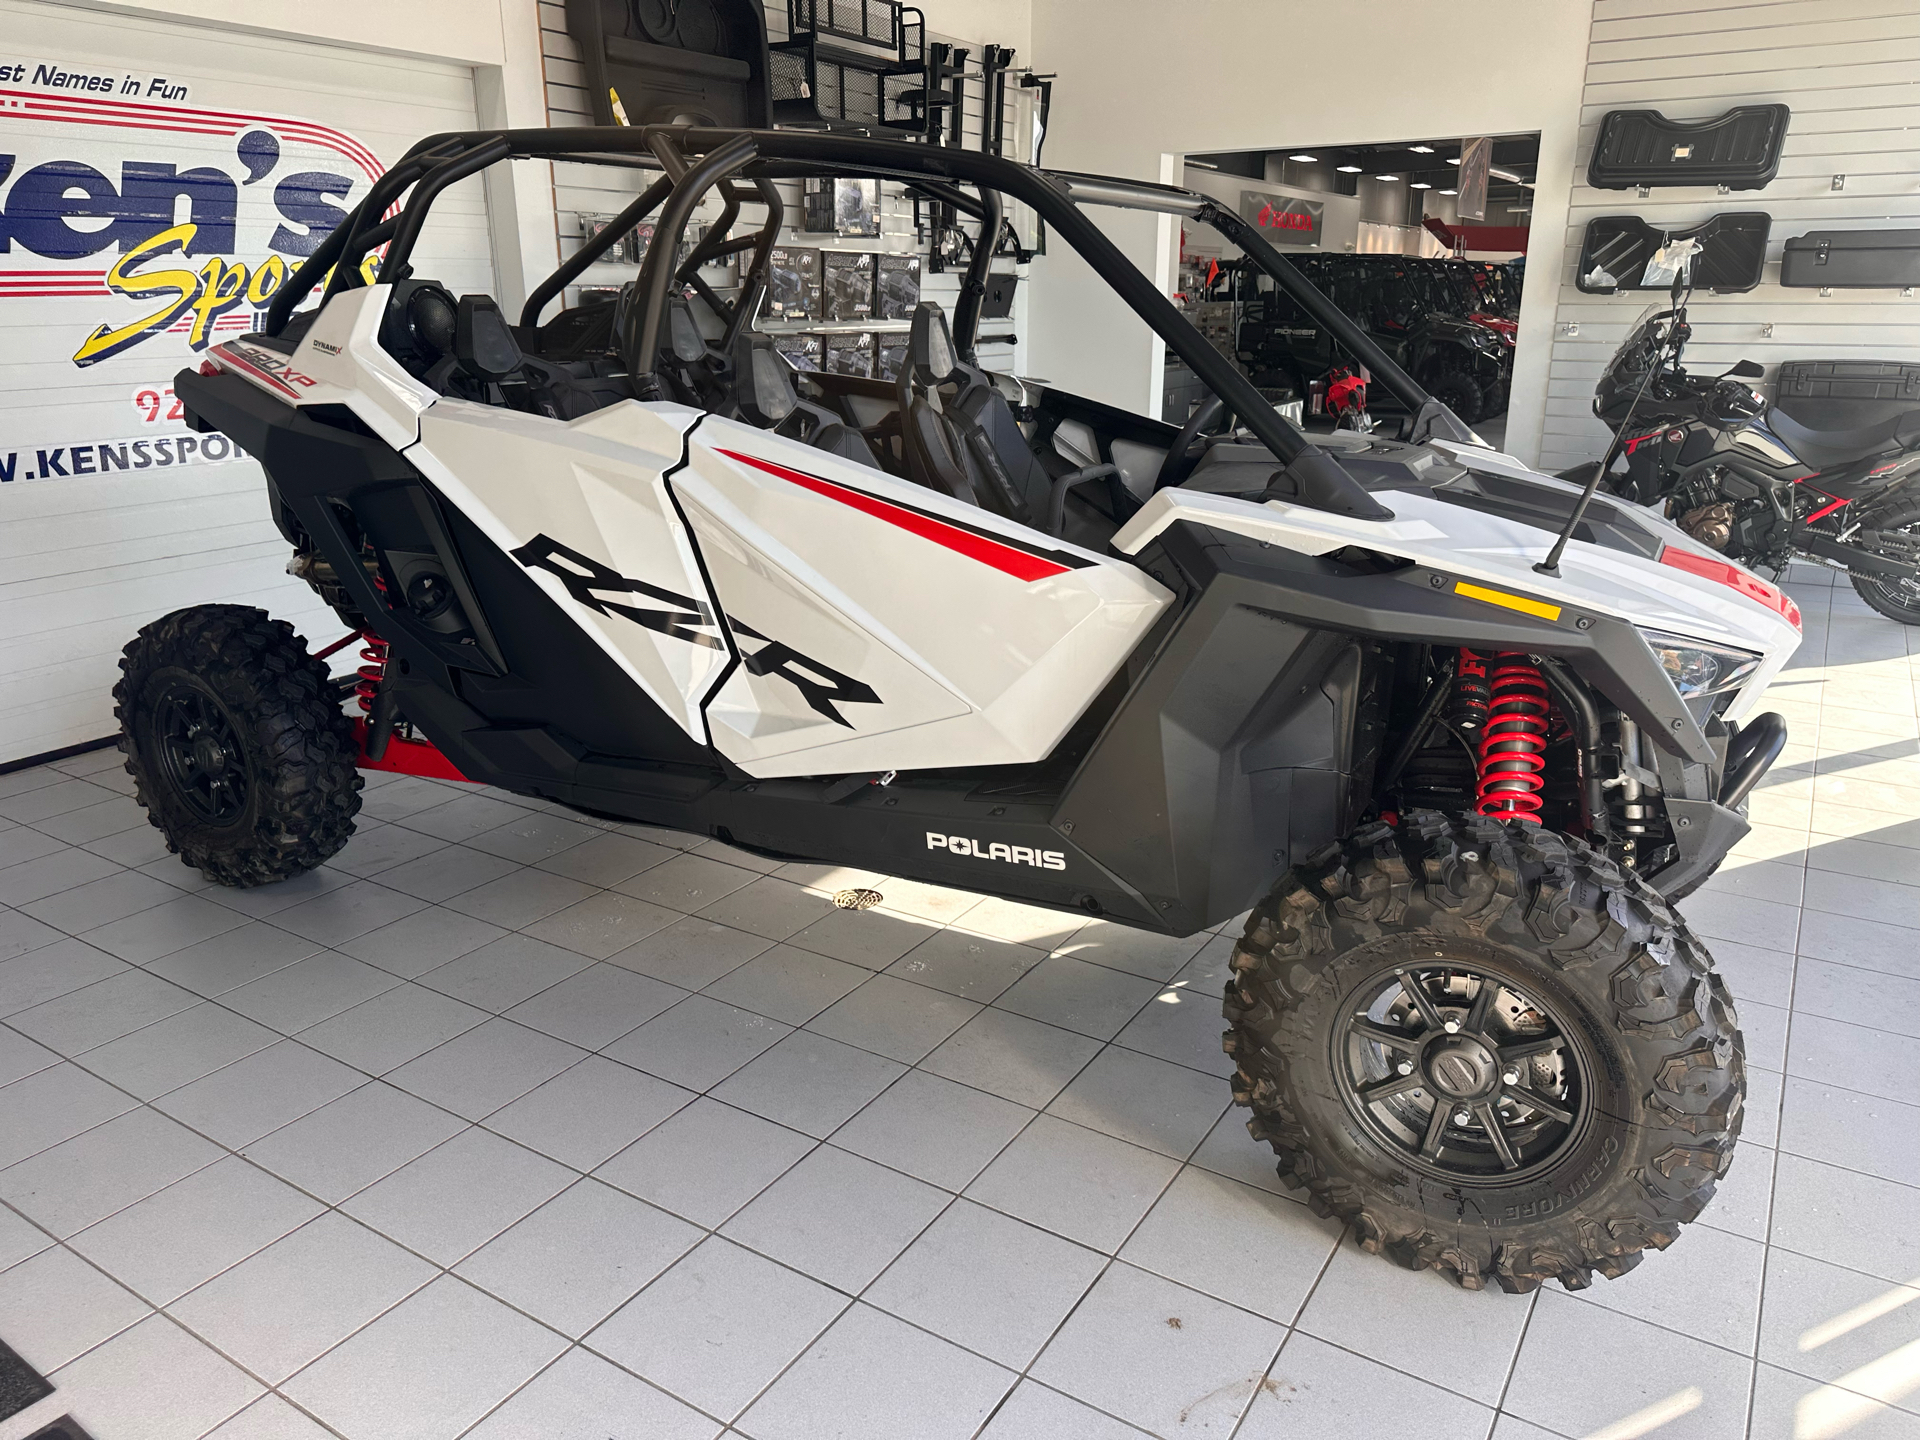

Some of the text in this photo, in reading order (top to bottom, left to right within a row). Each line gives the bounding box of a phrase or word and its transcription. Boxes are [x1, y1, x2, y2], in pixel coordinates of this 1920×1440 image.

[31, 64, 114, 93] Names
[120, 74, 141, 95] in
[147, 78, 188, 101] Fun
[1271, 210, 1313, 232] HONDA
[1274, 328, 1316, 336] PIONEER
[312, 339, 343, 355] DYNAMIX
[272, 367, 318, 387] XP
[508, 533, 885, 732] RZR
[926, 831, 1066, 871] POLARIS
